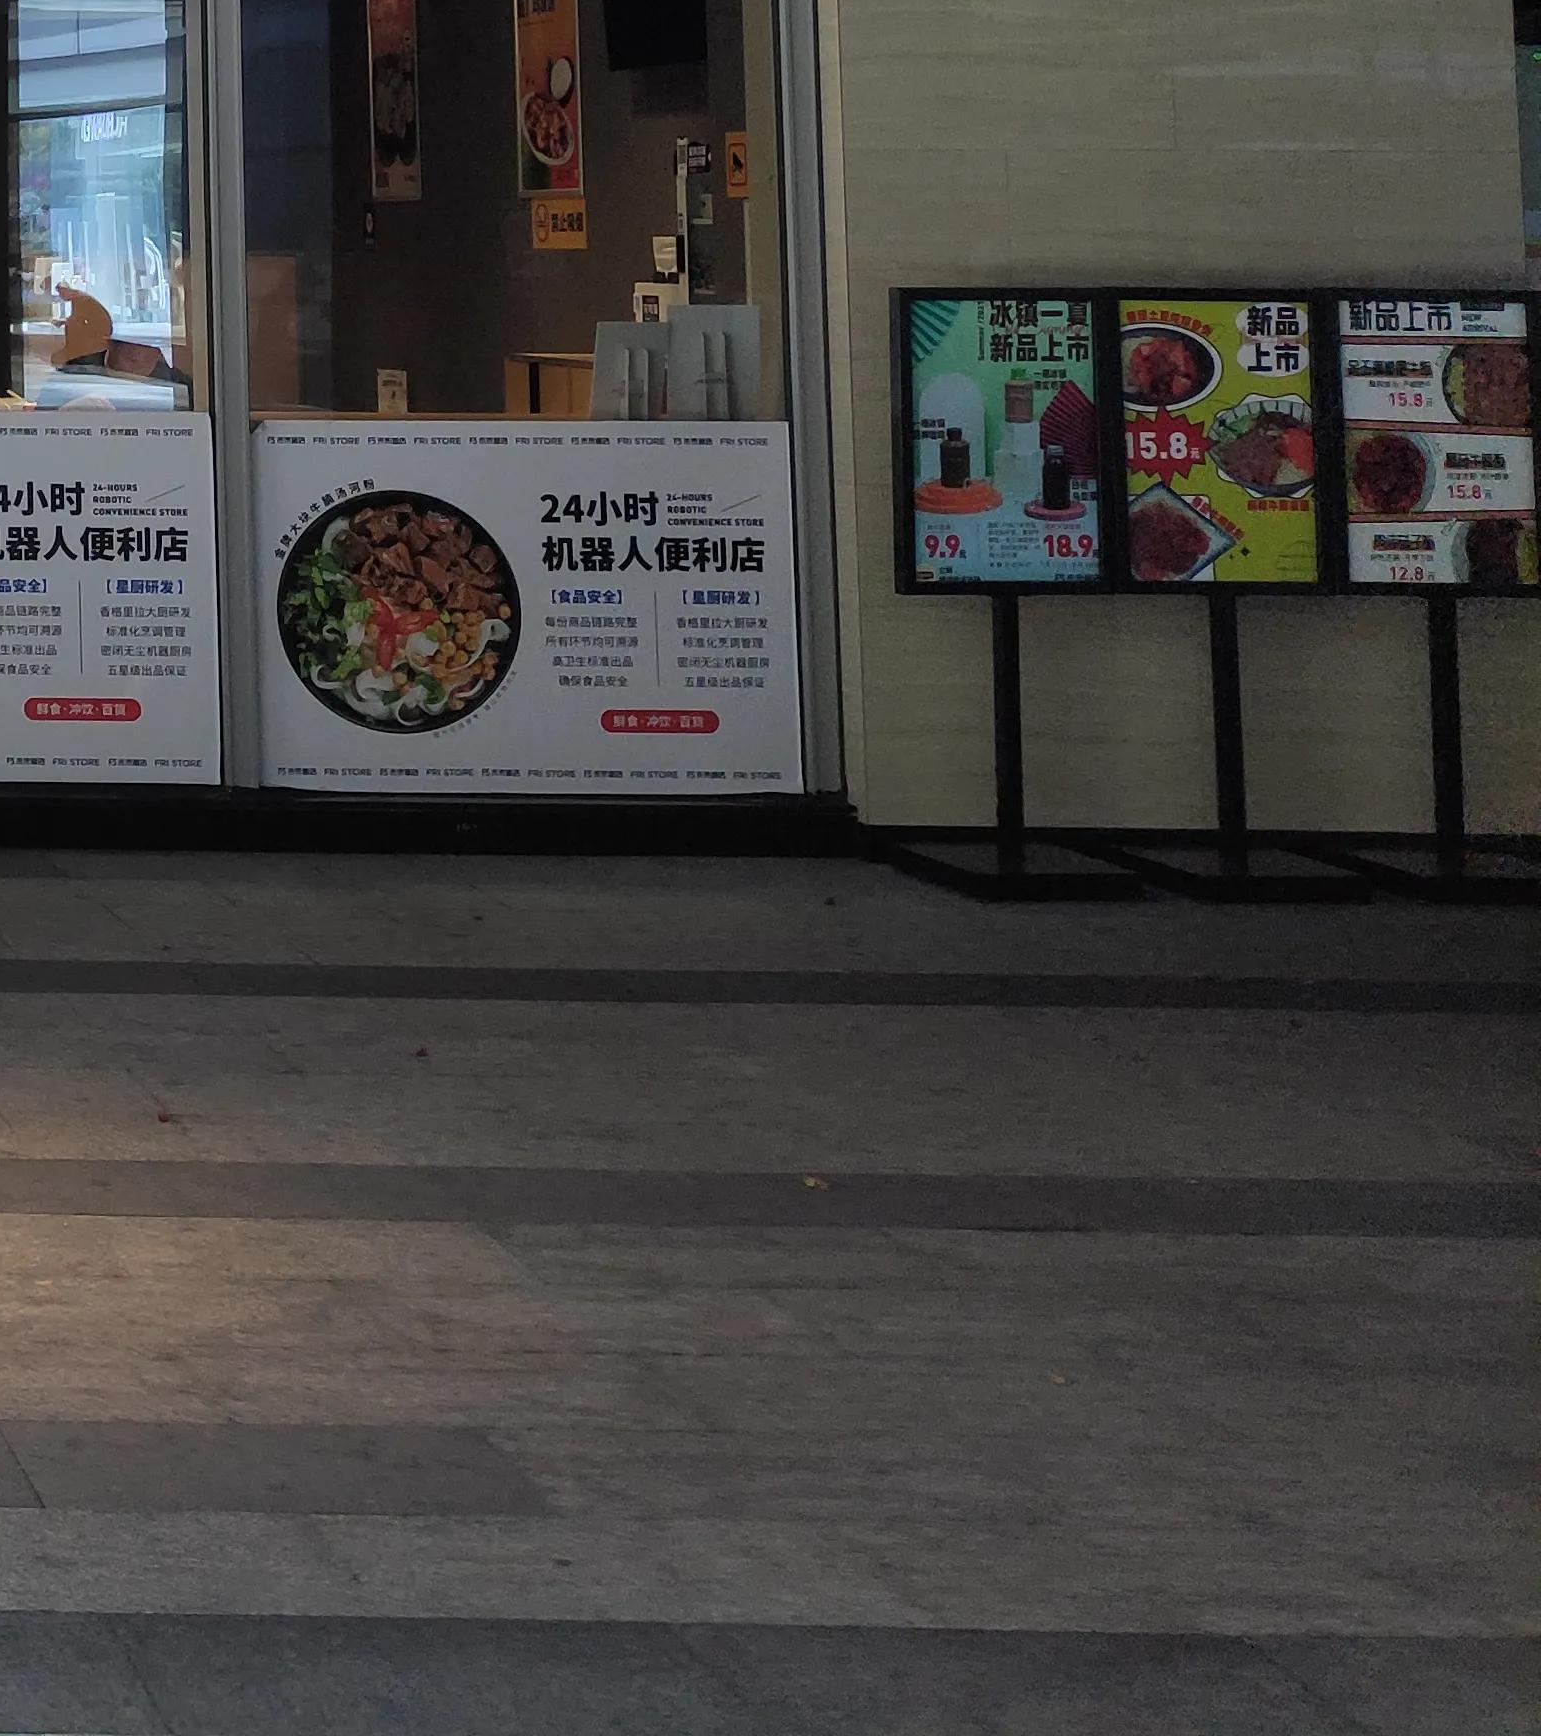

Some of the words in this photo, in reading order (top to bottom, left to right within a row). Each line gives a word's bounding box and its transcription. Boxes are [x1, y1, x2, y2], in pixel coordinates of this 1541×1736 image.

[1246, 305, 1300, 336] 新品
[1348, 300, 1453, 332] 新品上市
[989, 332, 1090, 362] 新品上市
[1247, 342, 1300, 373] 上市
[92, 496, 132, 504] ROBOTIC
[92, 508, 157, 516] CONVENIENCE
[159, 508, 189, 517] STORE
[540, 491, 659, 527] 24小时
[667, 505, 707, 514] ROBOTIC
[667, 518, 732, 527] CONVENIENCE
[734, 518, 765, 527] STORE
[542, 535, 765, 573] 机器人便利店
